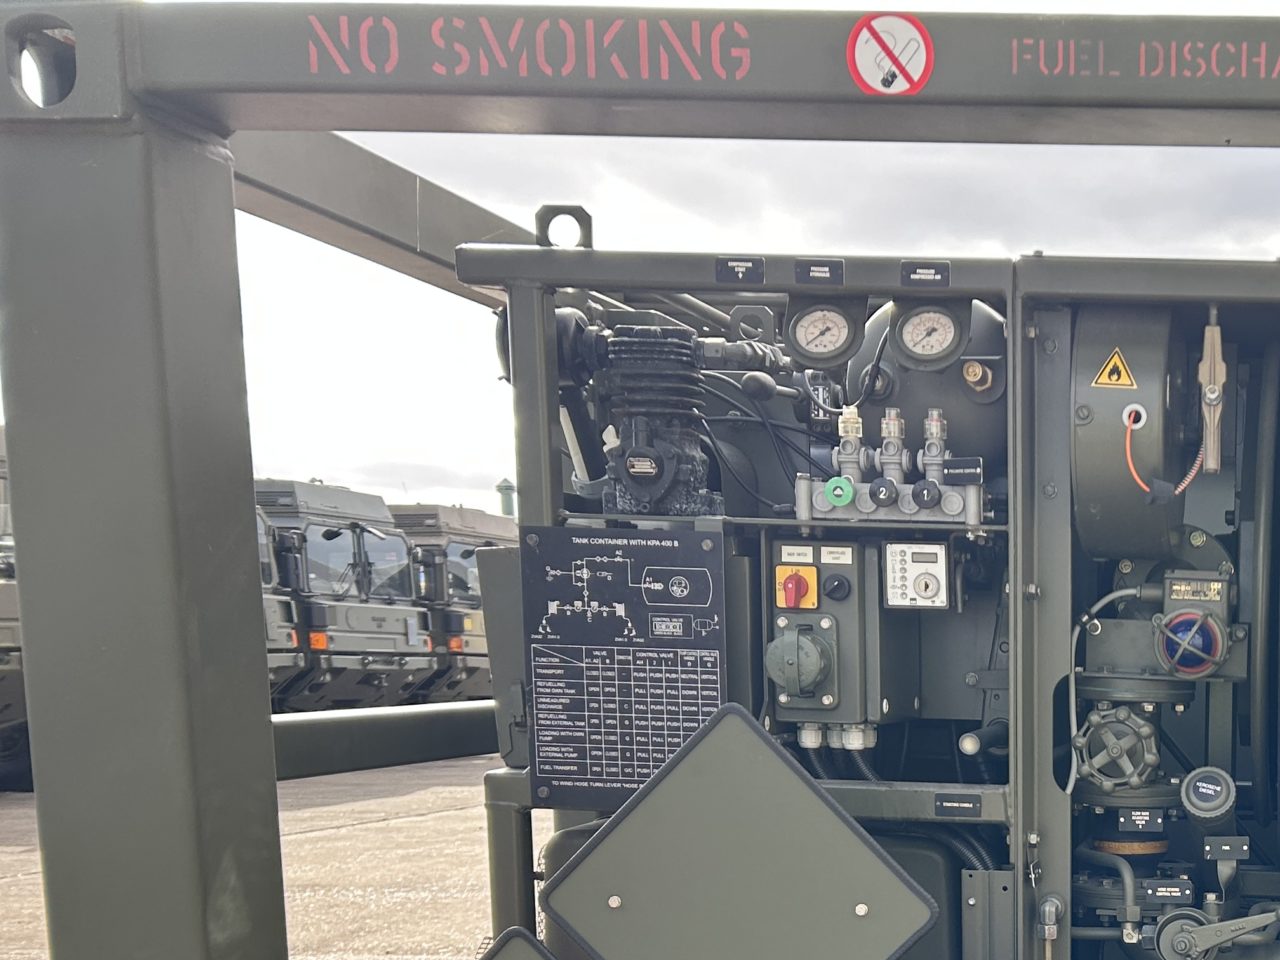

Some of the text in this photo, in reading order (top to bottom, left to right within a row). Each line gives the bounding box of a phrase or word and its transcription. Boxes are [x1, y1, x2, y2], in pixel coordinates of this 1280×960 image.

[309, 15, 751, 81] NO SMOKING
[1011, 38, 1119, 77] FUEL
[880, 488, 886, 497] 2
[923, 490, 928, 500] 1
[1196, 782, 1221, 791] KEROSENE
